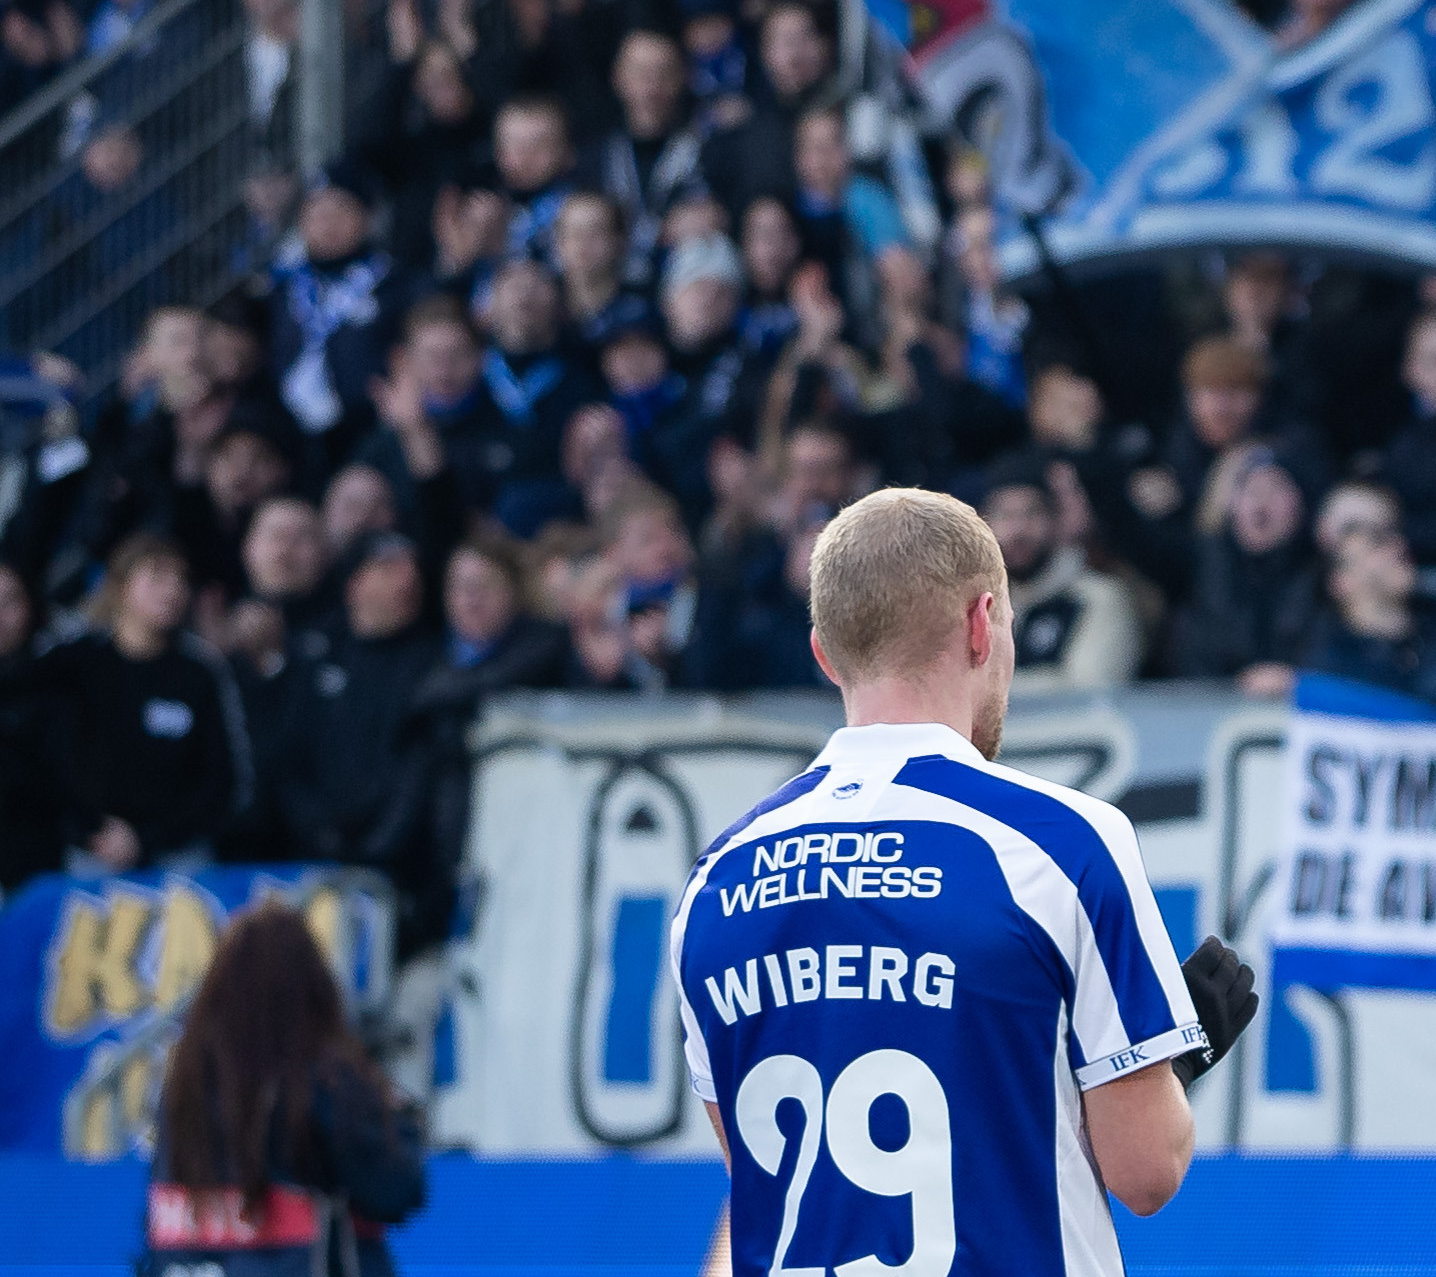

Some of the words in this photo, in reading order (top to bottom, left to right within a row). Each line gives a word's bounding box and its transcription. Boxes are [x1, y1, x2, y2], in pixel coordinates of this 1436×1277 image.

[752, 832, 904, 872] NORDIC
[719, 867, 943, 918] WELLNESS
[704, 945, 957, 1027] WIBERG
[1109, 1045, 1149, 1072] IFK
